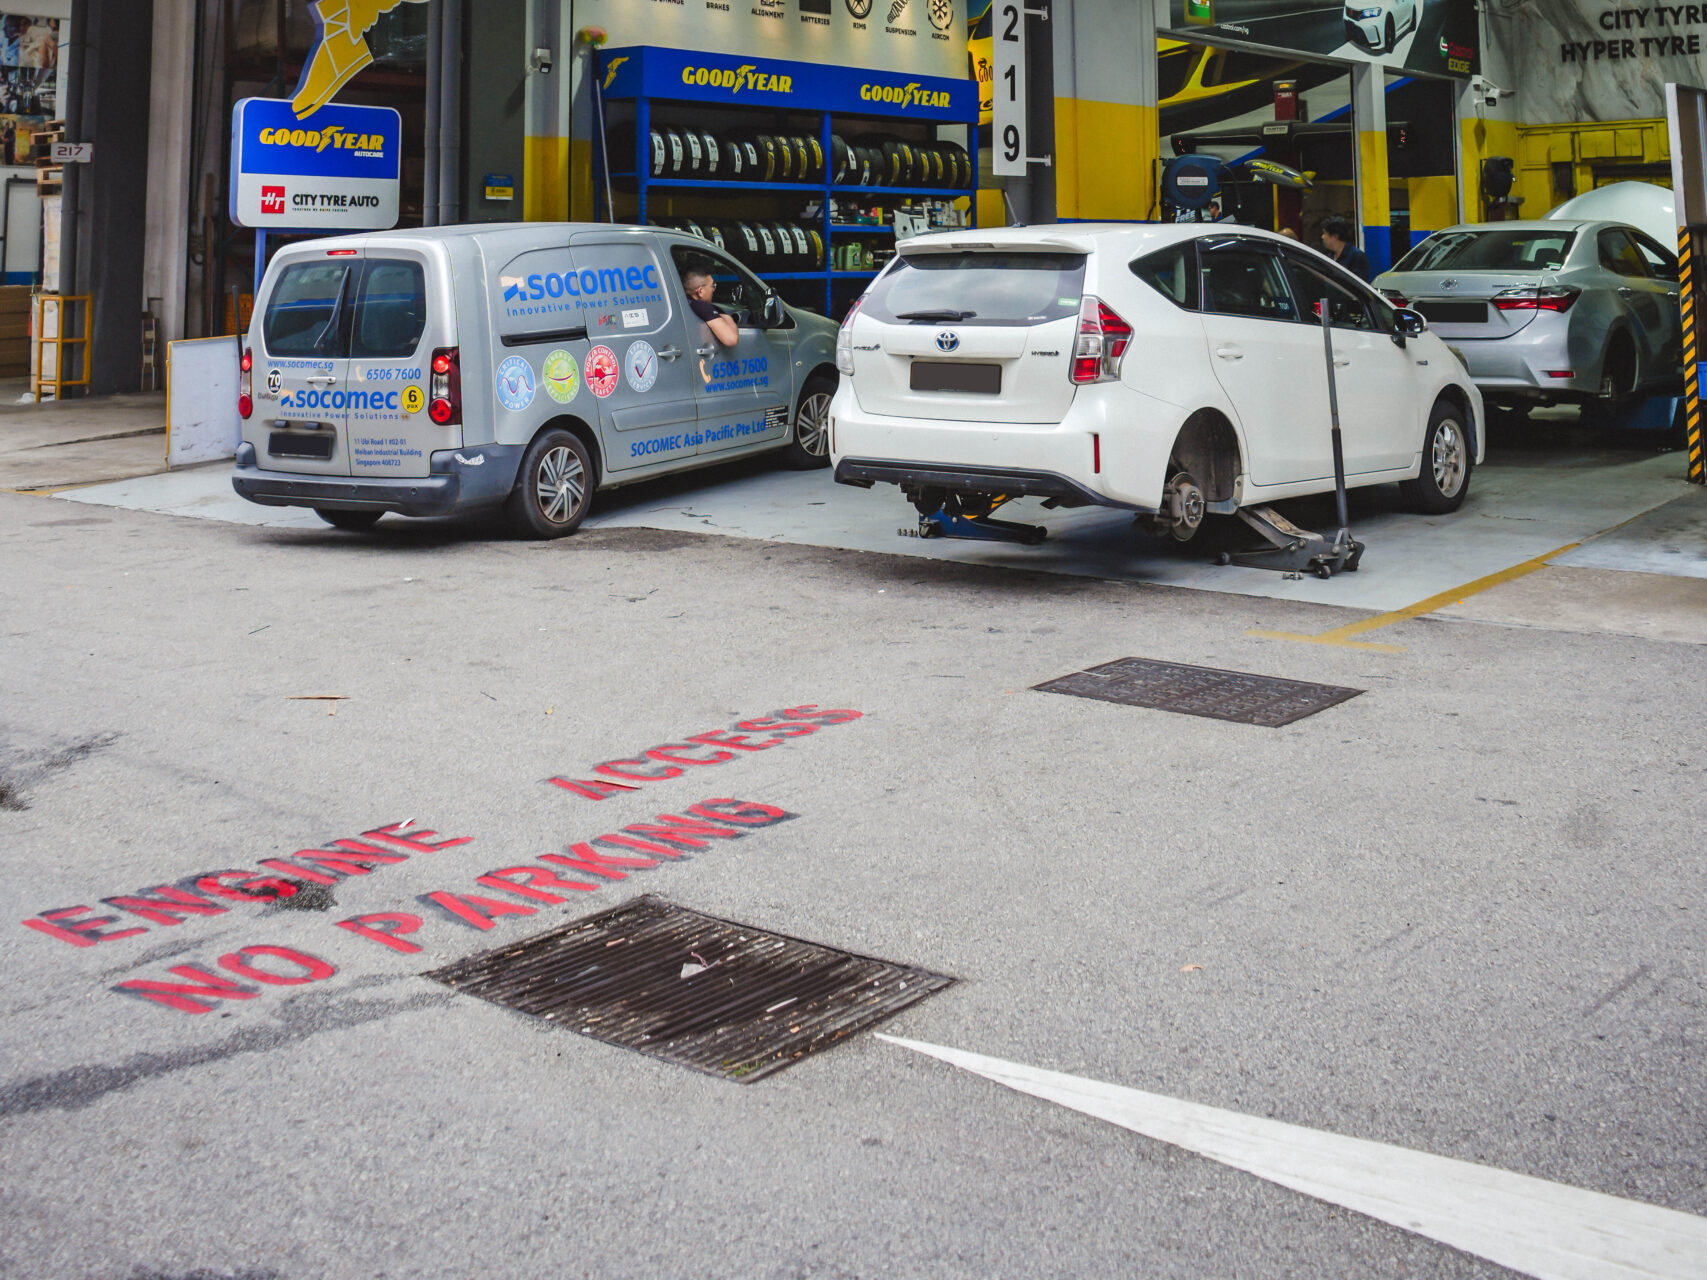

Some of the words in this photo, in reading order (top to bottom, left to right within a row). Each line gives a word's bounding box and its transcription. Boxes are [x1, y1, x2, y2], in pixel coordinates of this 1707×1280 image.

[706, 1, 730, 11] BRAKES
[751, 8, 785, 19] ALIGNMENT
[800, 15, 830, 26] BATTERIES
[853, 22, 866, 30] RIMS
[1600, 8, 1649, 31] CITY
[885, 26, 917, 37] SUSPENSION
[931, 33, 950, 41] AIRCON
[1561, 38, 1636, 63] HYPER
[1640, 34, 1700, 58] TYRE
[1448, 58, 1470, 74] EDGE
[682, 64, 792, 94] GOODYEAR
[860, 82, 950, 109] GOODYEAR
[259, 125, 384, 153] GOODYEAR
[57, 146, 84, 156] 217
[261, 192, 285, 210] HT
[292, 194, 317, 205] CITY
[319, 194, 347, 206] TYRE
[349, 195, 379, 207] AUTO
[527, 264, 658, 300] socomec
[506, 303, 570, 317] Innovative
[576, 299, 608, 309] Power
[613, 293, 662, 305] Solutions
[267, 360, 334, 372] www.socomec.sg
[366, 368, 392, 380] 6506
[395, 367, 421, 380] 7600
[499, 358, 528, 375] CRITICAL
[712, 362, 740, 379] 6506
[742, 357, 767, 374] 7600
[270, 374, 281, 386] 70
[705, 375, 768, 393] www.socomec.sg
[295, 390, 398, 410] socomec
[408, 389, 417, 403] 6
[504, 396, 530, 409] POWER
[281, 410, 321, 419] Innovative
[325, 411, 350, 419] Power
[354, 412, 399, 420] Solutions
[631, 434, 681, 457] SOCOMEC
[683, 432, 703, 447] Asia
[705, 425, 734, 443] Pacific
[736, 423, 749, 438] Pte
[752, 417, 766, 433] Ltd
[374, 448, 399, 456] Industrial
[399, 449, 422, 458] Building
[356, 458, 381, 467] Singapore
[22, 822, 475, 949] ENGINE
[547, 702, 865, 801] ACCESS
[112, 943, 338, 1014] NO
[335, 797, 793, 953] PARKING
